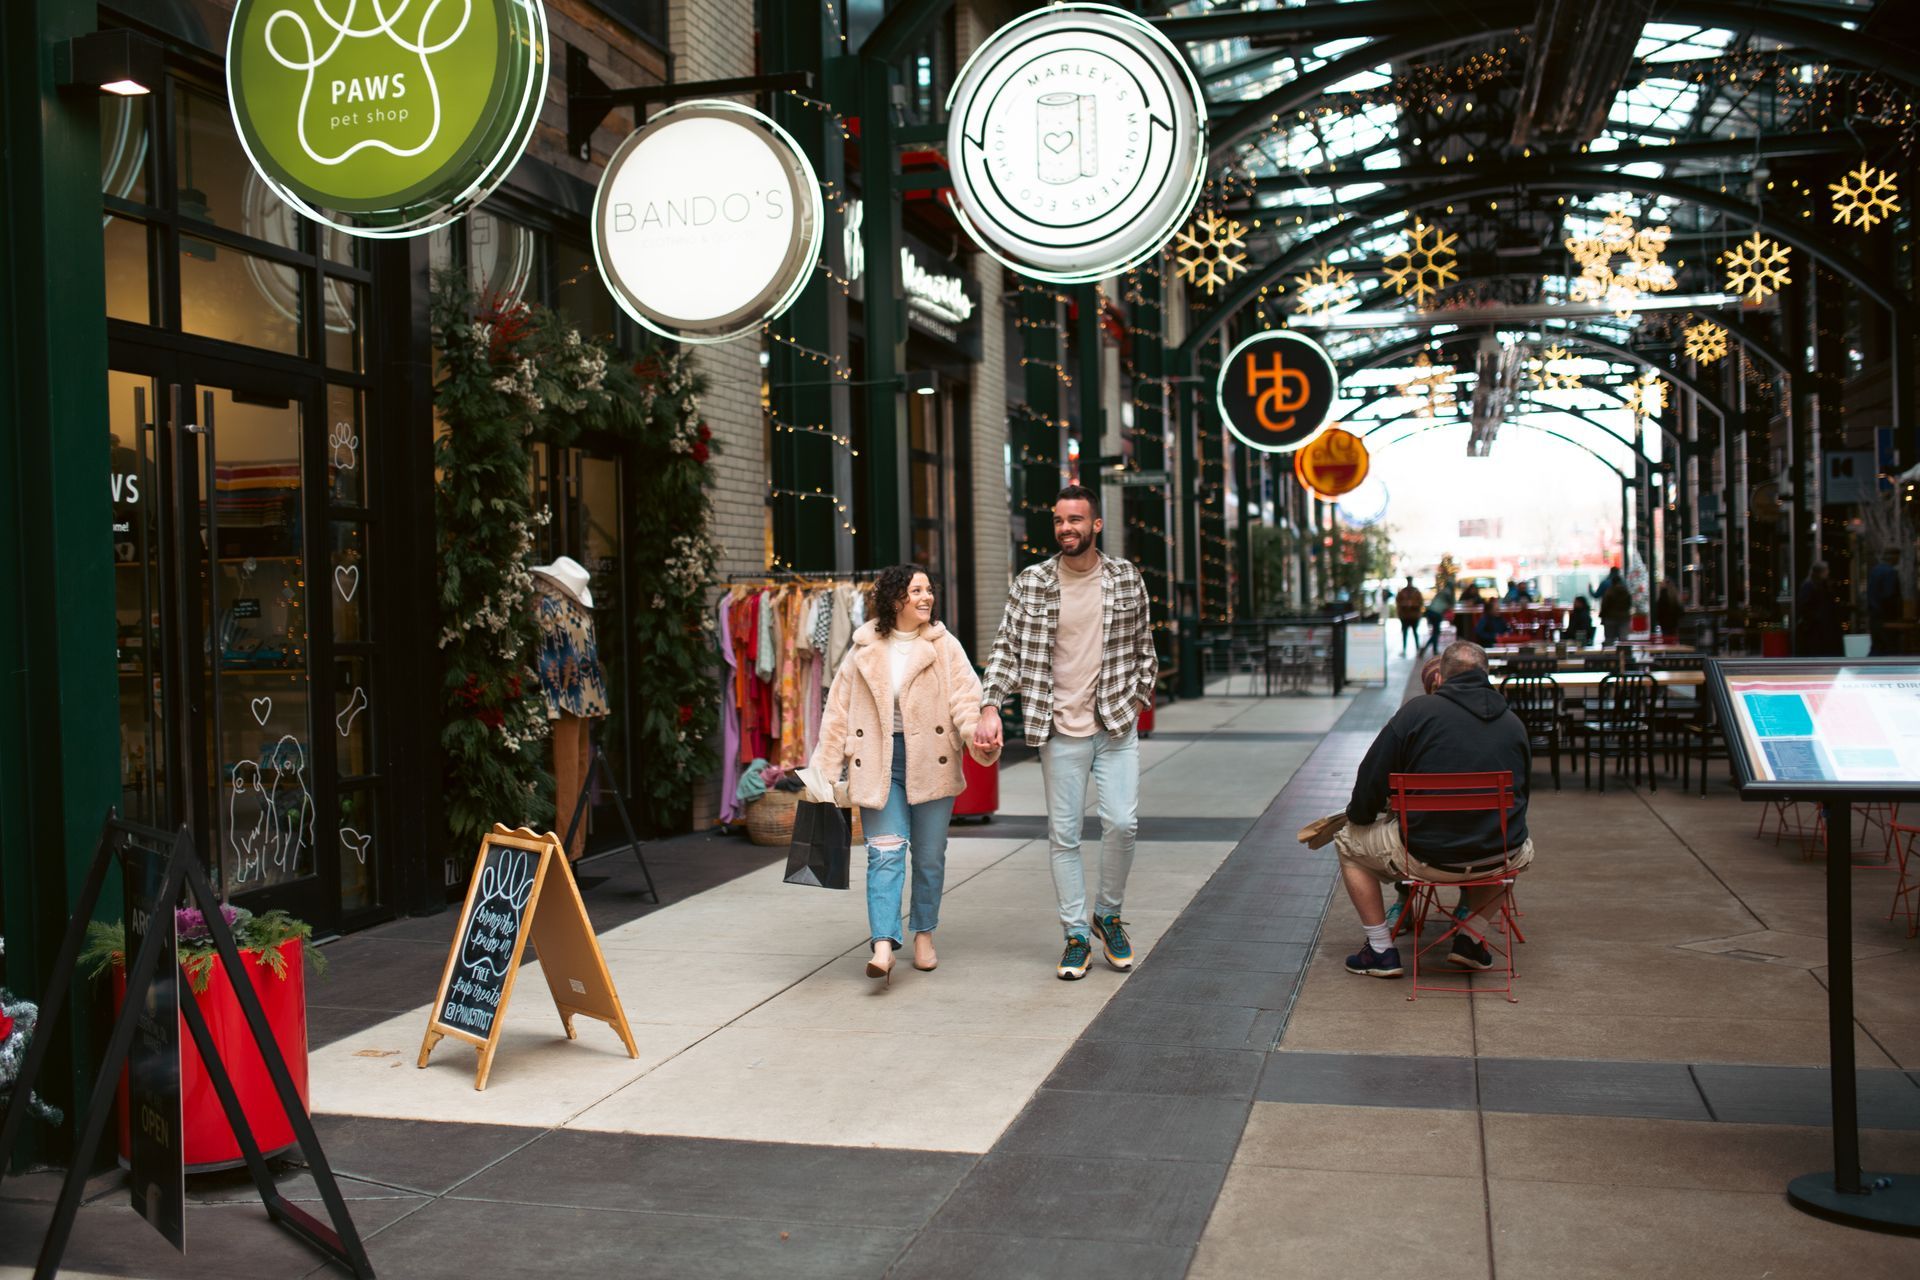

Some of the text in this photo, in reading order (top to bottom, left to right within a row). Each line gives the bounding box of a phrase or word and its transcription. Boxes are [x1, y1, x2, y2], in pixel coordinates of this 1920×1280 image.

[331, 72, 406, 105] PAWS
[330, 107, 409, 130] pet shop
[994, 64, 1140, 211] MARLEY'S MONSTERS ECO SHOP
[614, 189, 784, 233] BANDO'S
[1896, 681, 1920, 689] DIR
[476, 906, 516, 937] bring the
[470, 929, 512, 960] paws in
[472, 965, 491, 982] FREE
[451, 976, 502, 1008] pup treats
[141, 1103, 169, 1150] OPEN
